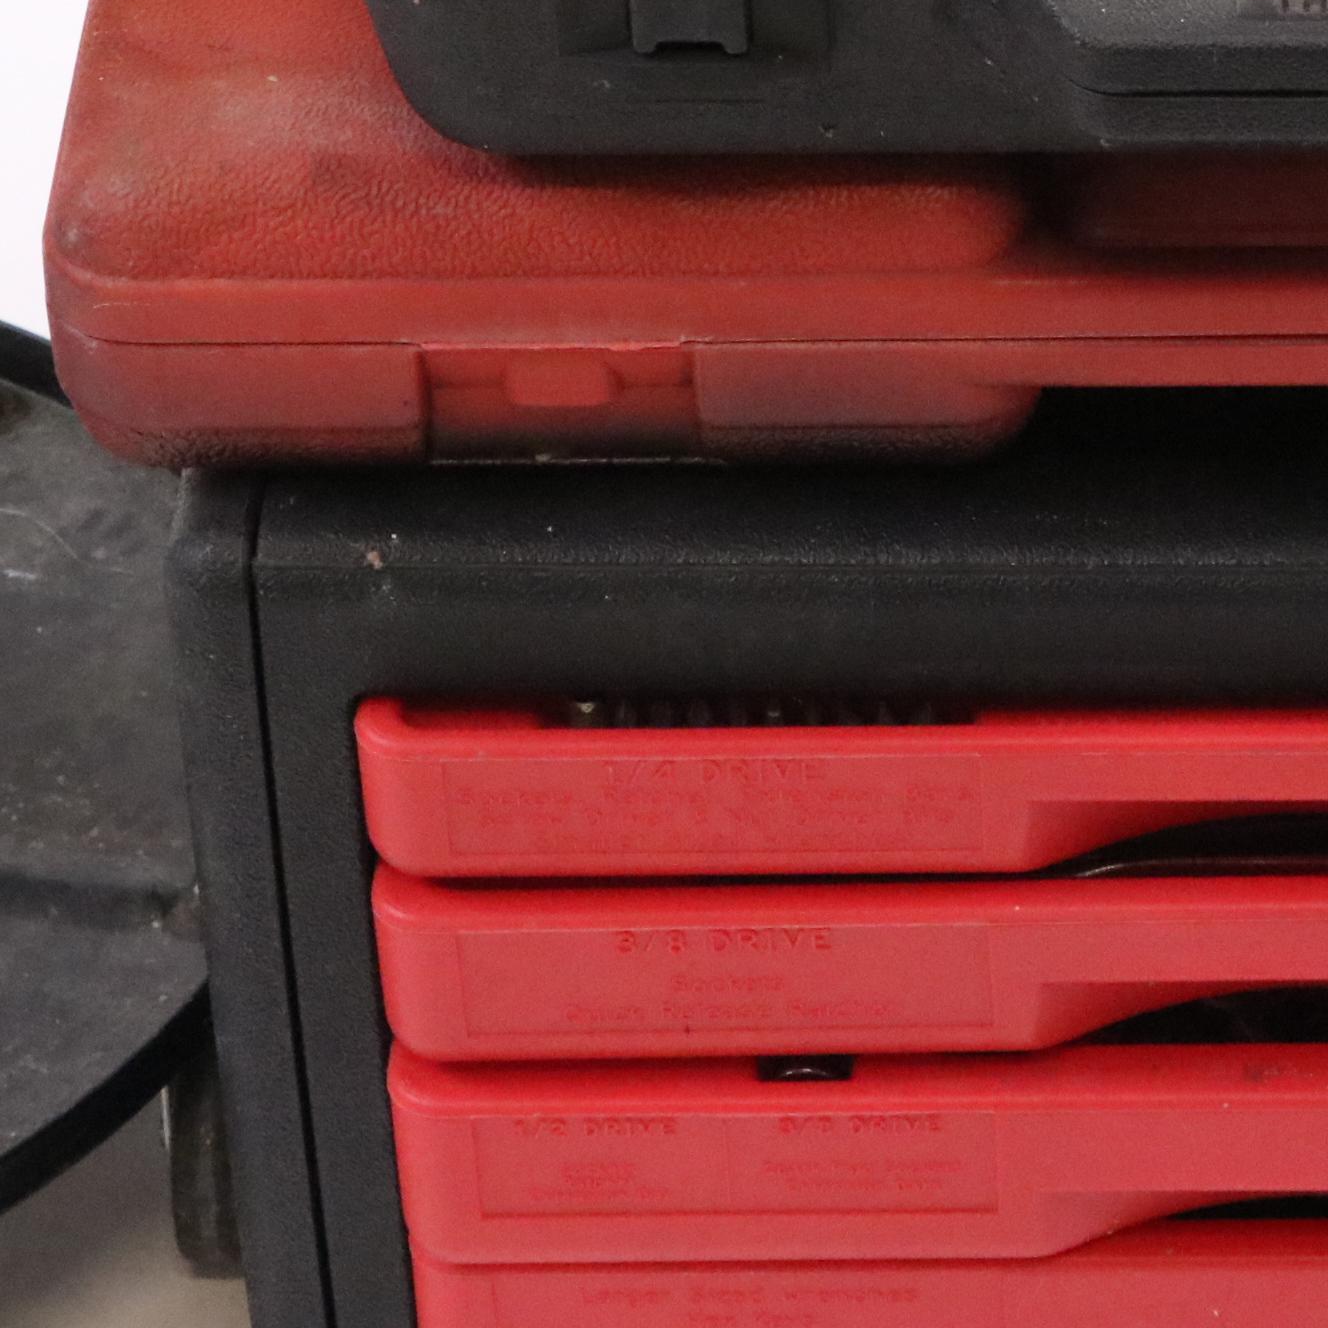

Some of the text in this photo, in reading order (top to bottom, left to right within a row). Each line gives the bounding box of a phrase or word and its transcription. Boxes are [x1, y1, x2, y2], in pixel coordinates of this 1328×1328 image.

[603, 758, 828, 785] 1/4 DRIVE
[615, 928, 835, 954] 3/8 DRIVE
[584, 1115, 678, 1137] DRIVE
[850, 1113, 943, 1134] DRIVE
